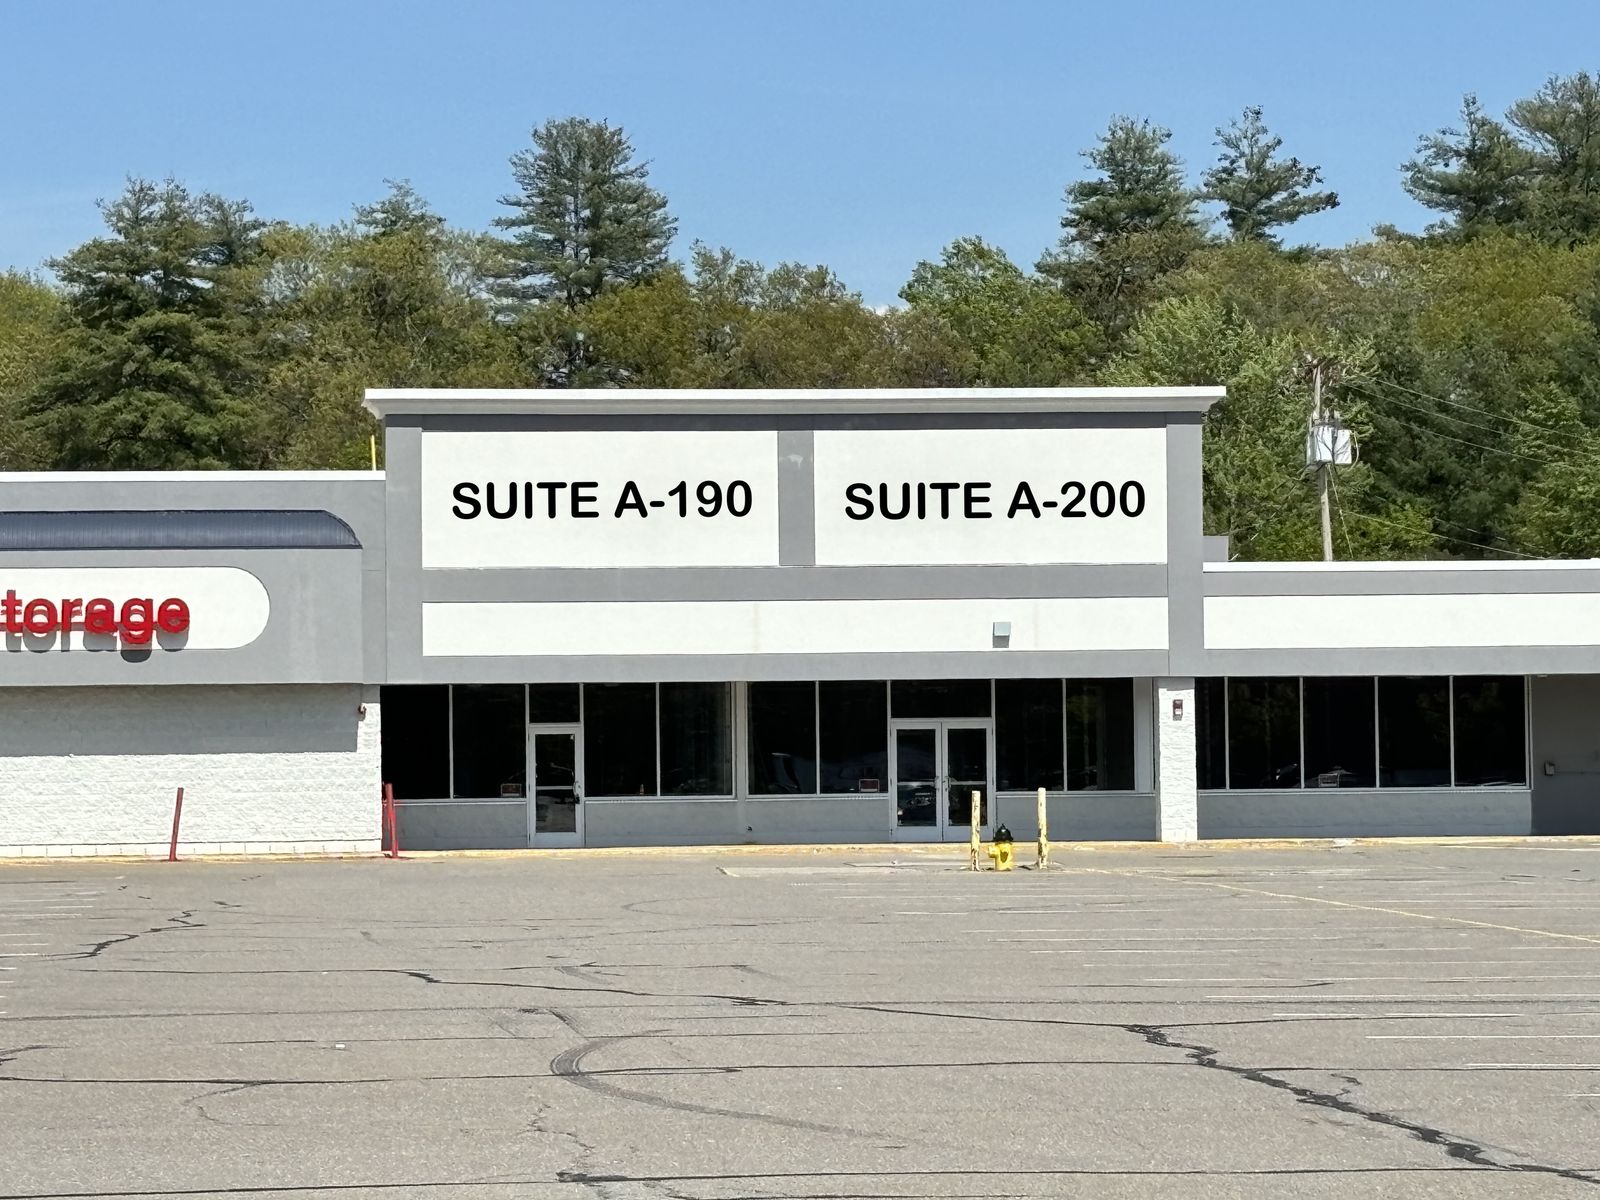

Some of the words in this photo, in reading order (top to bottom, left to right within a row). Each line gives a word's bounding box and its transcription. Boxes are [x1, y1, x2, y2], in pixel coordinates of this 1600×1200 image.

[452, 481, 599, 519] SUITE
[615, 480, 752, 518] A-190
[845, 482, 992, 520] SUITE
[1008, 480, 1145, 518] A-200
